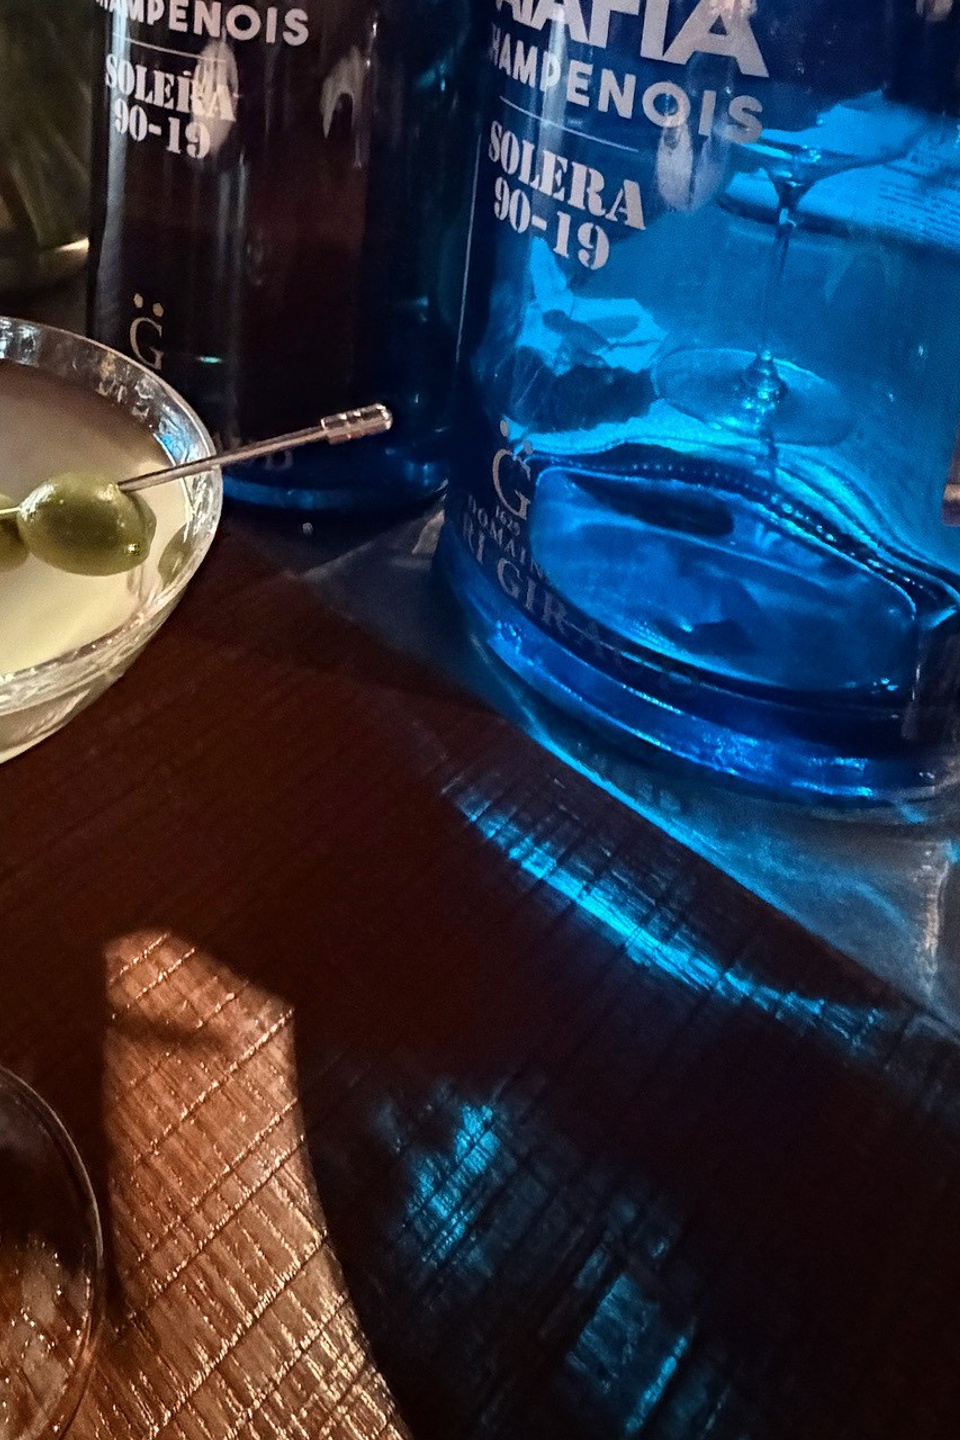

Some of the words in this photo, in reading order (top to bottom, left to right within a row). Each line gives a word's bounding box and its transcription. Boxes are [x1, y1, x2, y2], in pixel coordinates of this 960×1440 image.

[105, 54, 237, 122] SOLERA
[115, 98, 211, 160] 90-19
[490, 22, 763, 144] HAMPENOIS
[489, 120, 646, 231] SOLERA
[493, 176, 610, 270] 90-19
